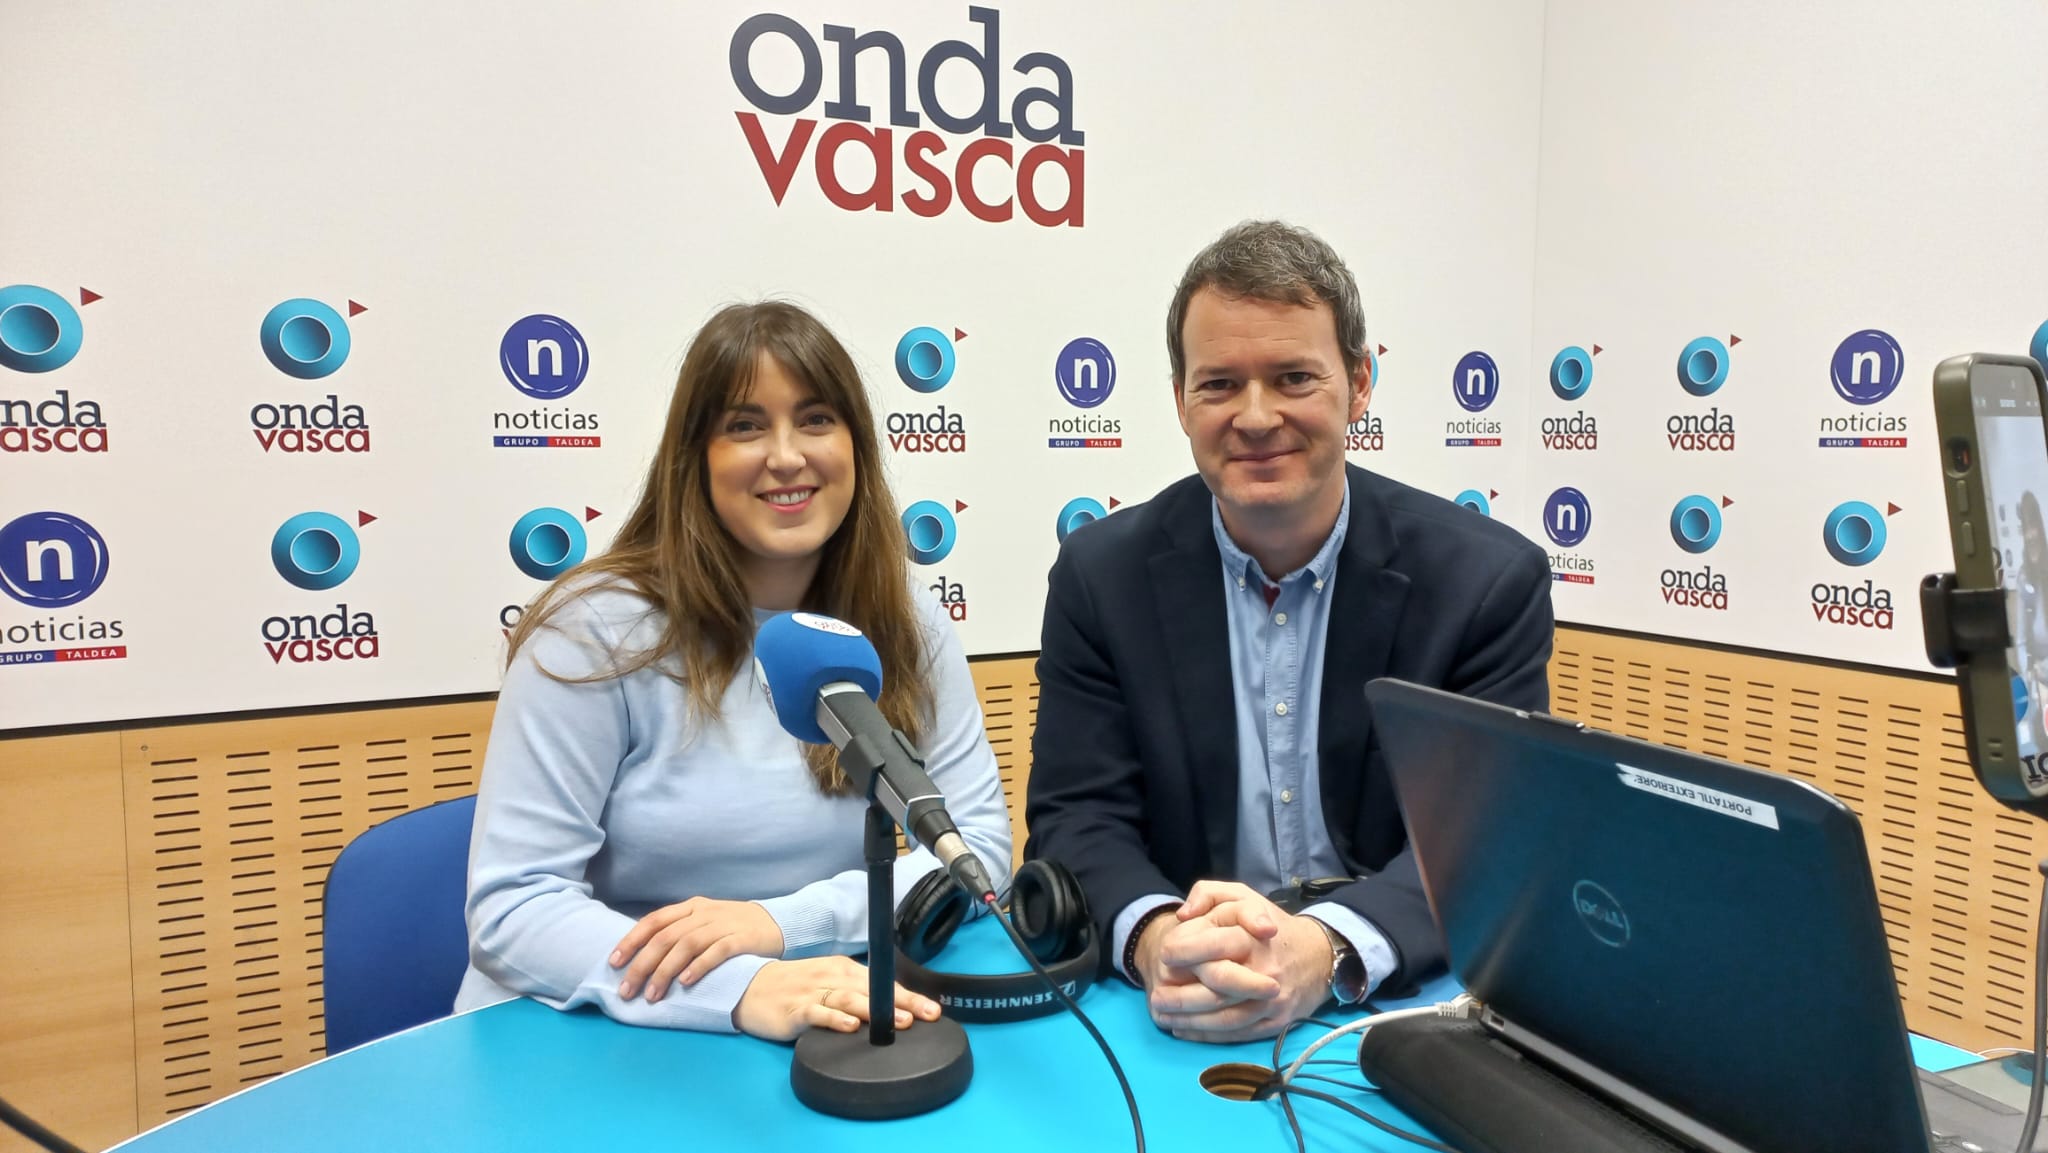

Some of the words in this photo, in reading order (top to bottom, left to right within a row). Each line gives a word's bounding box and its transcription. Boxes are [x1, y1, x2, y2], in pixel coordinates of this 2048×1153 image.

[729, 5, 1085, 146] onda
[734, 110, 1085, 227] vasca
[527, 339, 563, 376] n
[1851, 351, 1881, 384] n
[1074, 358, 1098, 389] n
[1466, 368, 1486, 395] n
[0, 390, 107, 427] nda
[250, 395, 369, 429] onda
[494, 408, 599, 430] noticias
[886, 405, 966, 434] onda
[1666, 407, 1735, 434] onda
[1049, 414, 1122, 433] noticias
[1350, 411, 1384, 434] da
[1446, 418, 1502, 434] noticias
[1541, 411, 1598, 434] onda
[1820, 412, 1907, 432] noticias
[0, 427, 108, 453] asca
[253, 429, 370, 453] vasca
[503, 438, 540, 446] GRUPO
[555, 438, 594, 446] TALDEA
[887, 433, 966, 453] vasca
[1541, 434, 1598, 450] vasca
[1667, 433, 1735, 451] vasca
[1826, 439, 1855, 447] GRUPO
[1867, 439, 1901, 447] TALDEA
[1557, 504, 1577, 531] n
[26, 539, 74, 582] n
[1547, 553, 1595, 571] oticias
[929, 576, 967, 603] da
[1660, 565, 1728, 593] onda
[1661, 587, 1728, 610] vasca
[1811, 579, 1894, 610] onda
[261, 604, 378, 641] onda
[1812, 603, 1894, 630] vasca
[66, 649, 117, 660] TALDEA
[264, 636, 380, 664] vasca
[1634, 775, 1696, 799] EXTERIORE
[1699, 792, 1753, 816] PORTATIL
[940, 991, 1054, 1009] SENNHEISER
